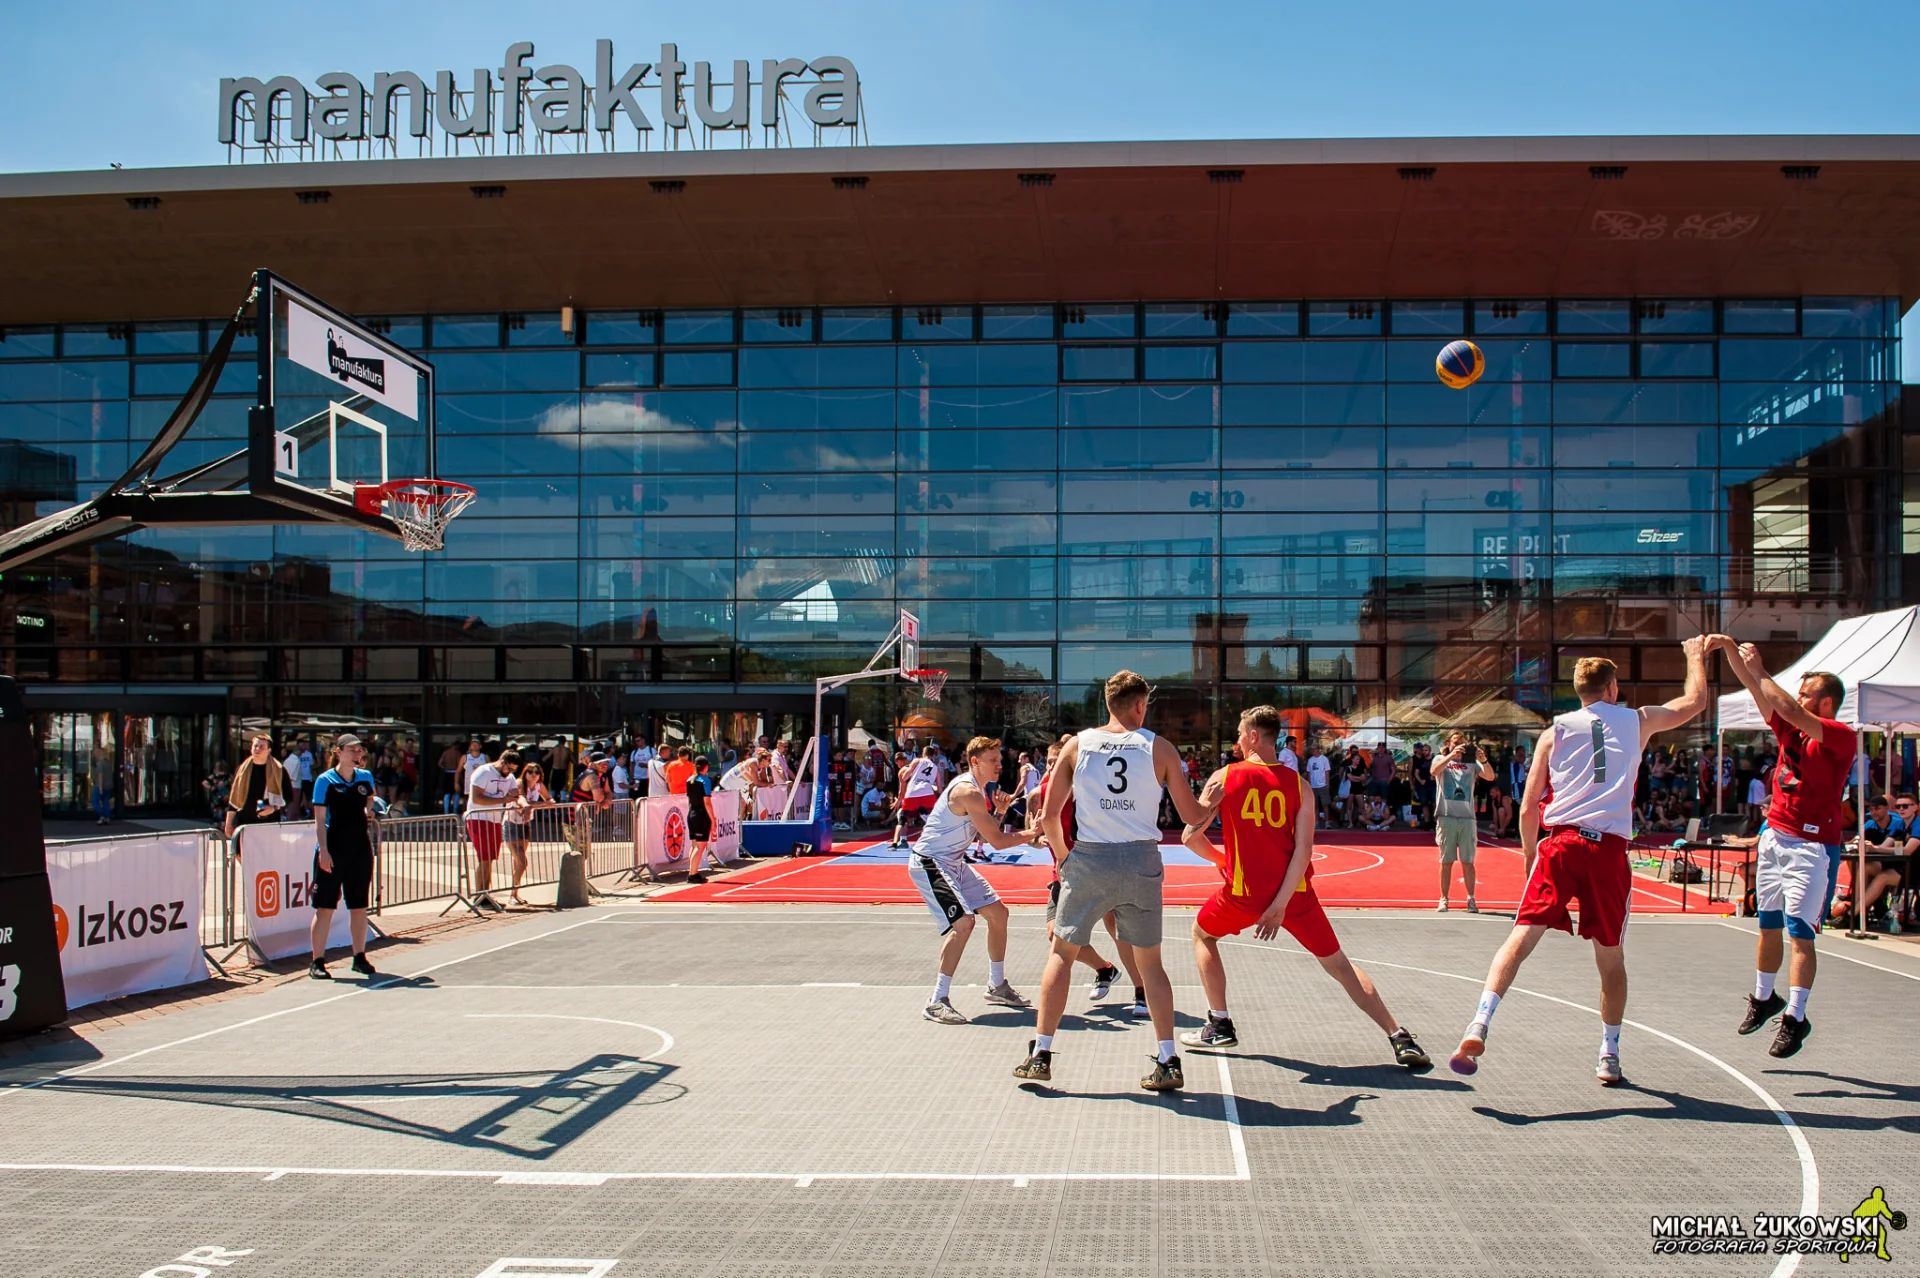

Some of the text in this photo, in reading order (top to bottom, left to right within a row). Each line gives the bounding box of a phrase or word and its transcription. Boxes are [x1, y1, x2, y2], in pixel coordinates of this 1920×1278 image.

[218, 39, 860, 143] manufaktura
[331, 354, 383, 386] manufaktura
[282, 441, 293, 470] 1
[921, 766, 934, 777] 4
[1106, 756, 1128, 795] 3
[1241, 788, 1287, 828] 40
